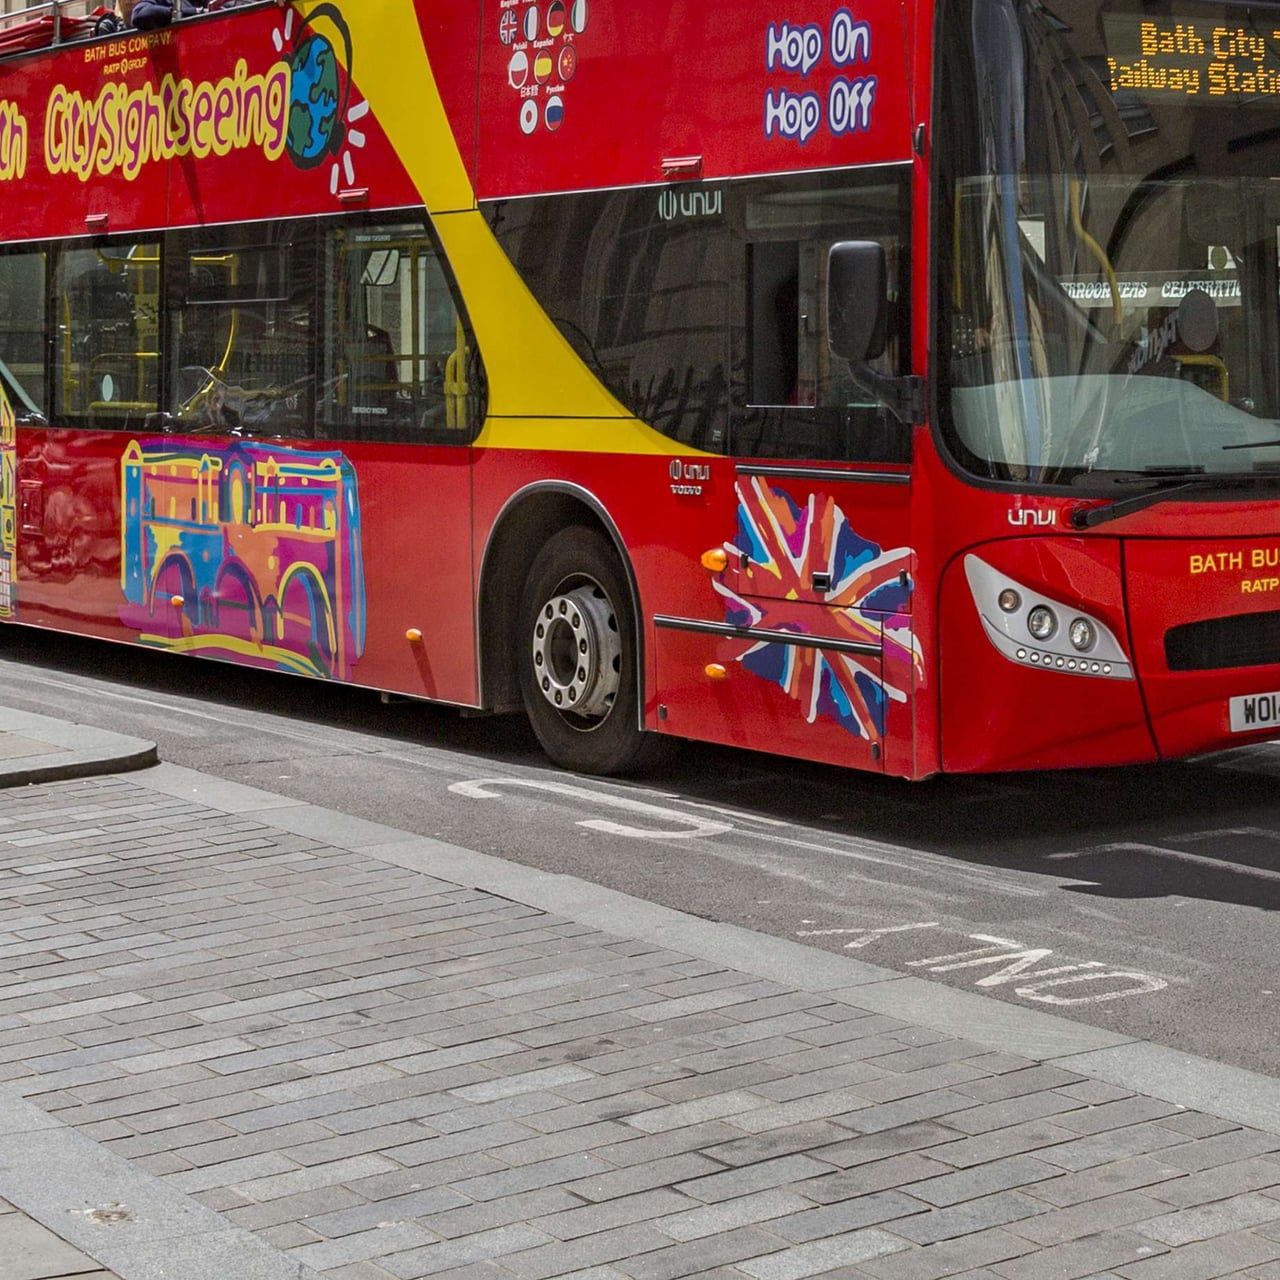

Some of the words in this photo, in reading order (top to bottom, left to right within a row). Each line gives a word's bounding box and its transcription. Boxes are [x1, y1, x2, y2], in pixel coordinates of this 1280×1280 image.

[84, 46, 107, 63] BATH
[108, 40, 128, 57] BUS
[767, 23, 823, 75] Hop
[830, 11, 870, 64] On
[1141, 22, 1205, 56] Bath
[1212, 27, 1266, 61] City
[103, 62, 121, 75] RATP
[765, 90, 821, 142] Hop
[829, 80, 875, 132] Off
[669, 484, 702, 495] VOLVO
[1189, 551, 1243, 573] BATH
[1241, 578, 1280, 593] RATP
